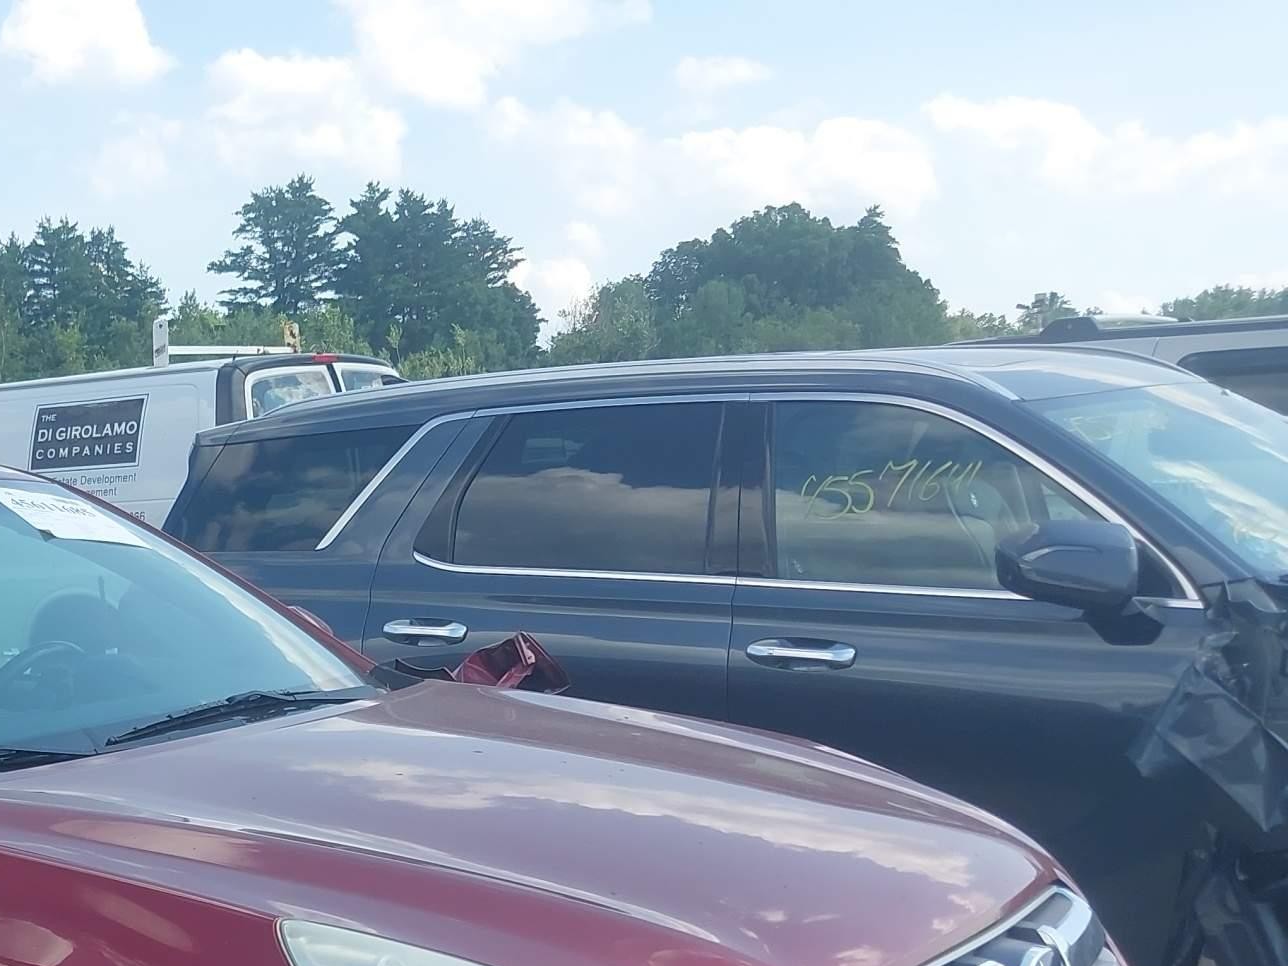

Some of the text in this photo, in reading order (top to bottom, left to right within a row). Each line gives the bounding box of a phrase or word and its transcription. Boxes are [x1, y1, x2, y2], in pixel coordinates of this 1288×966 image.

[41, 414, 57, 422] THE
[37, 420, 138, 442] DI GIROLAMO
[35, 442, 134, 459] COMPANIES
[80, 472, 137, 485] Development
